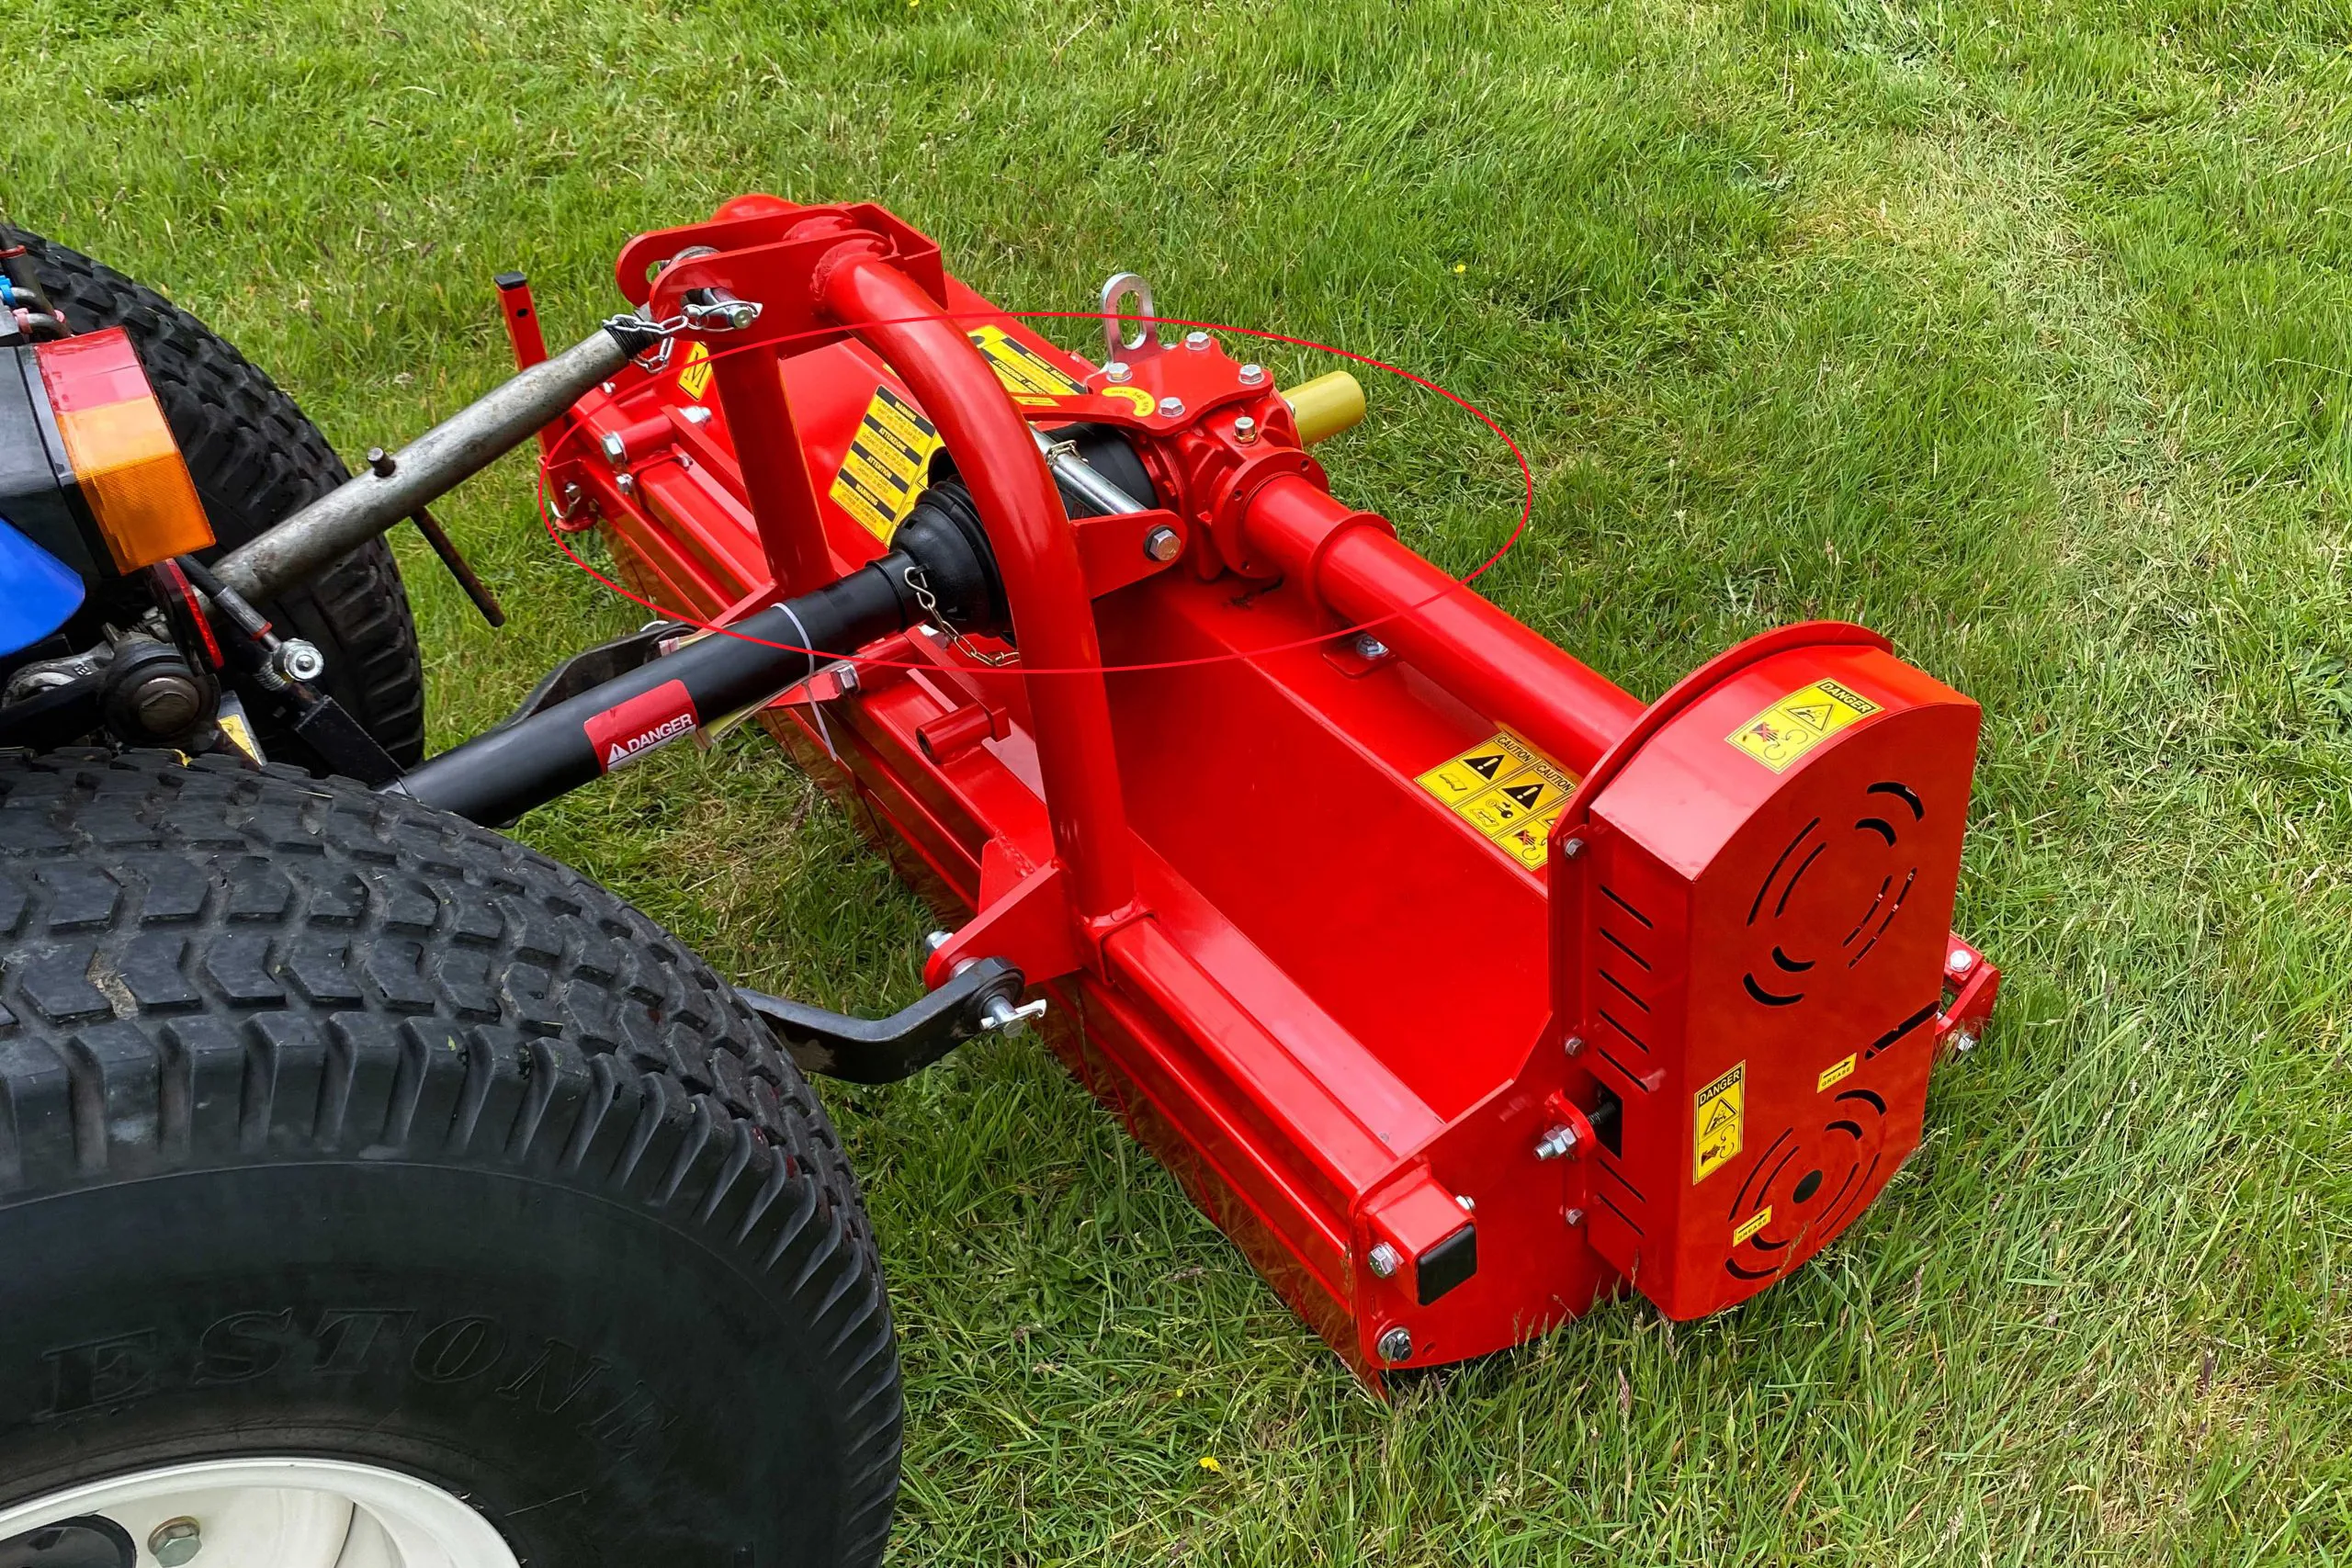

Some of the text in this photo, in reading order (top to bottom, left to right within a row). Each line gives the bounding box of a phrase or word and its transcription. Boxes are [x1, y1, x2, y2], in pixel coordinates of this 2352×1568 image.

[866, 455, 893, 479] ATTENTION
[1819, 682, 1872, 713] DANGER
[627, 713, 693, 753] DANGER
[1497, 737, 1532, 761] CAUTION
[1536, 764, 1574, 792] CAUTION
[1700, 1069, 1740, 1105] DANGER
[1822, 1066, 1851, 1087] GREASE
